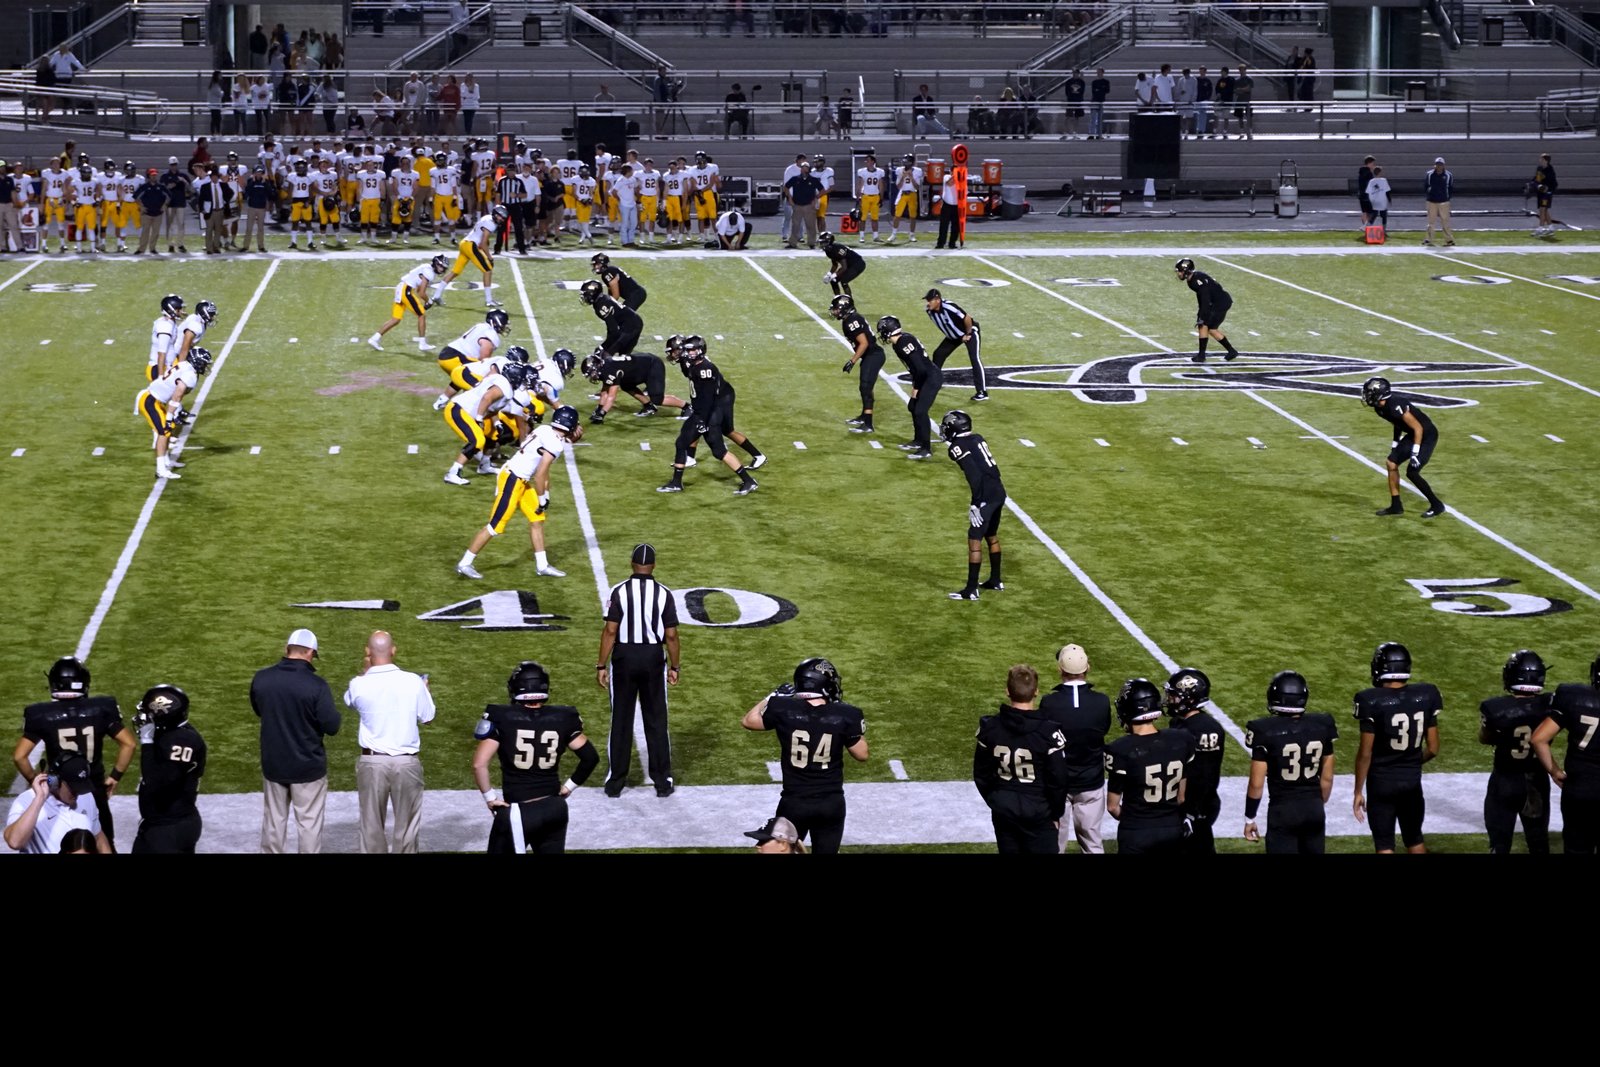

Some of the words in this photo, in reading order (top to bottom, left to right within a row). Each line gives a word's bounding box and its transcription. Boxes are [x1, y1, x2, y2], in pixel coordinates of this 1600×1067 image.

[502, 135, 510, 153] 1
[563, 167, 576, 178] 96
[365, 178, 377, 188] 63
[645, 179, 656, 188] 62
[668, 180, 679, 189] 28
[697, 175, 709, 186] 78
[969, 203, 977, 211] G
[842, 217, 858, 230] 50
[1367, 228, 1384, 241] 40
[848, 320, 861, 332] 28
[902, 342, 915, 355] 50
[700, 369, 712, 379] 90
[950, 445, 963, 458] 19
[1390, 710, 1425, 751] 31
[57, 725, 95, 763] 51
[1200, 733, 1219, 748] 48
[170, 745, 193, 762] 20
[513, 729, 560, 769] 53
[790, 730, 833, 769] 64
[993, 745, 1036, 783] 36
[1281, 740, 1323, 781] 33
[1143, 760, 1184, 803] 52
